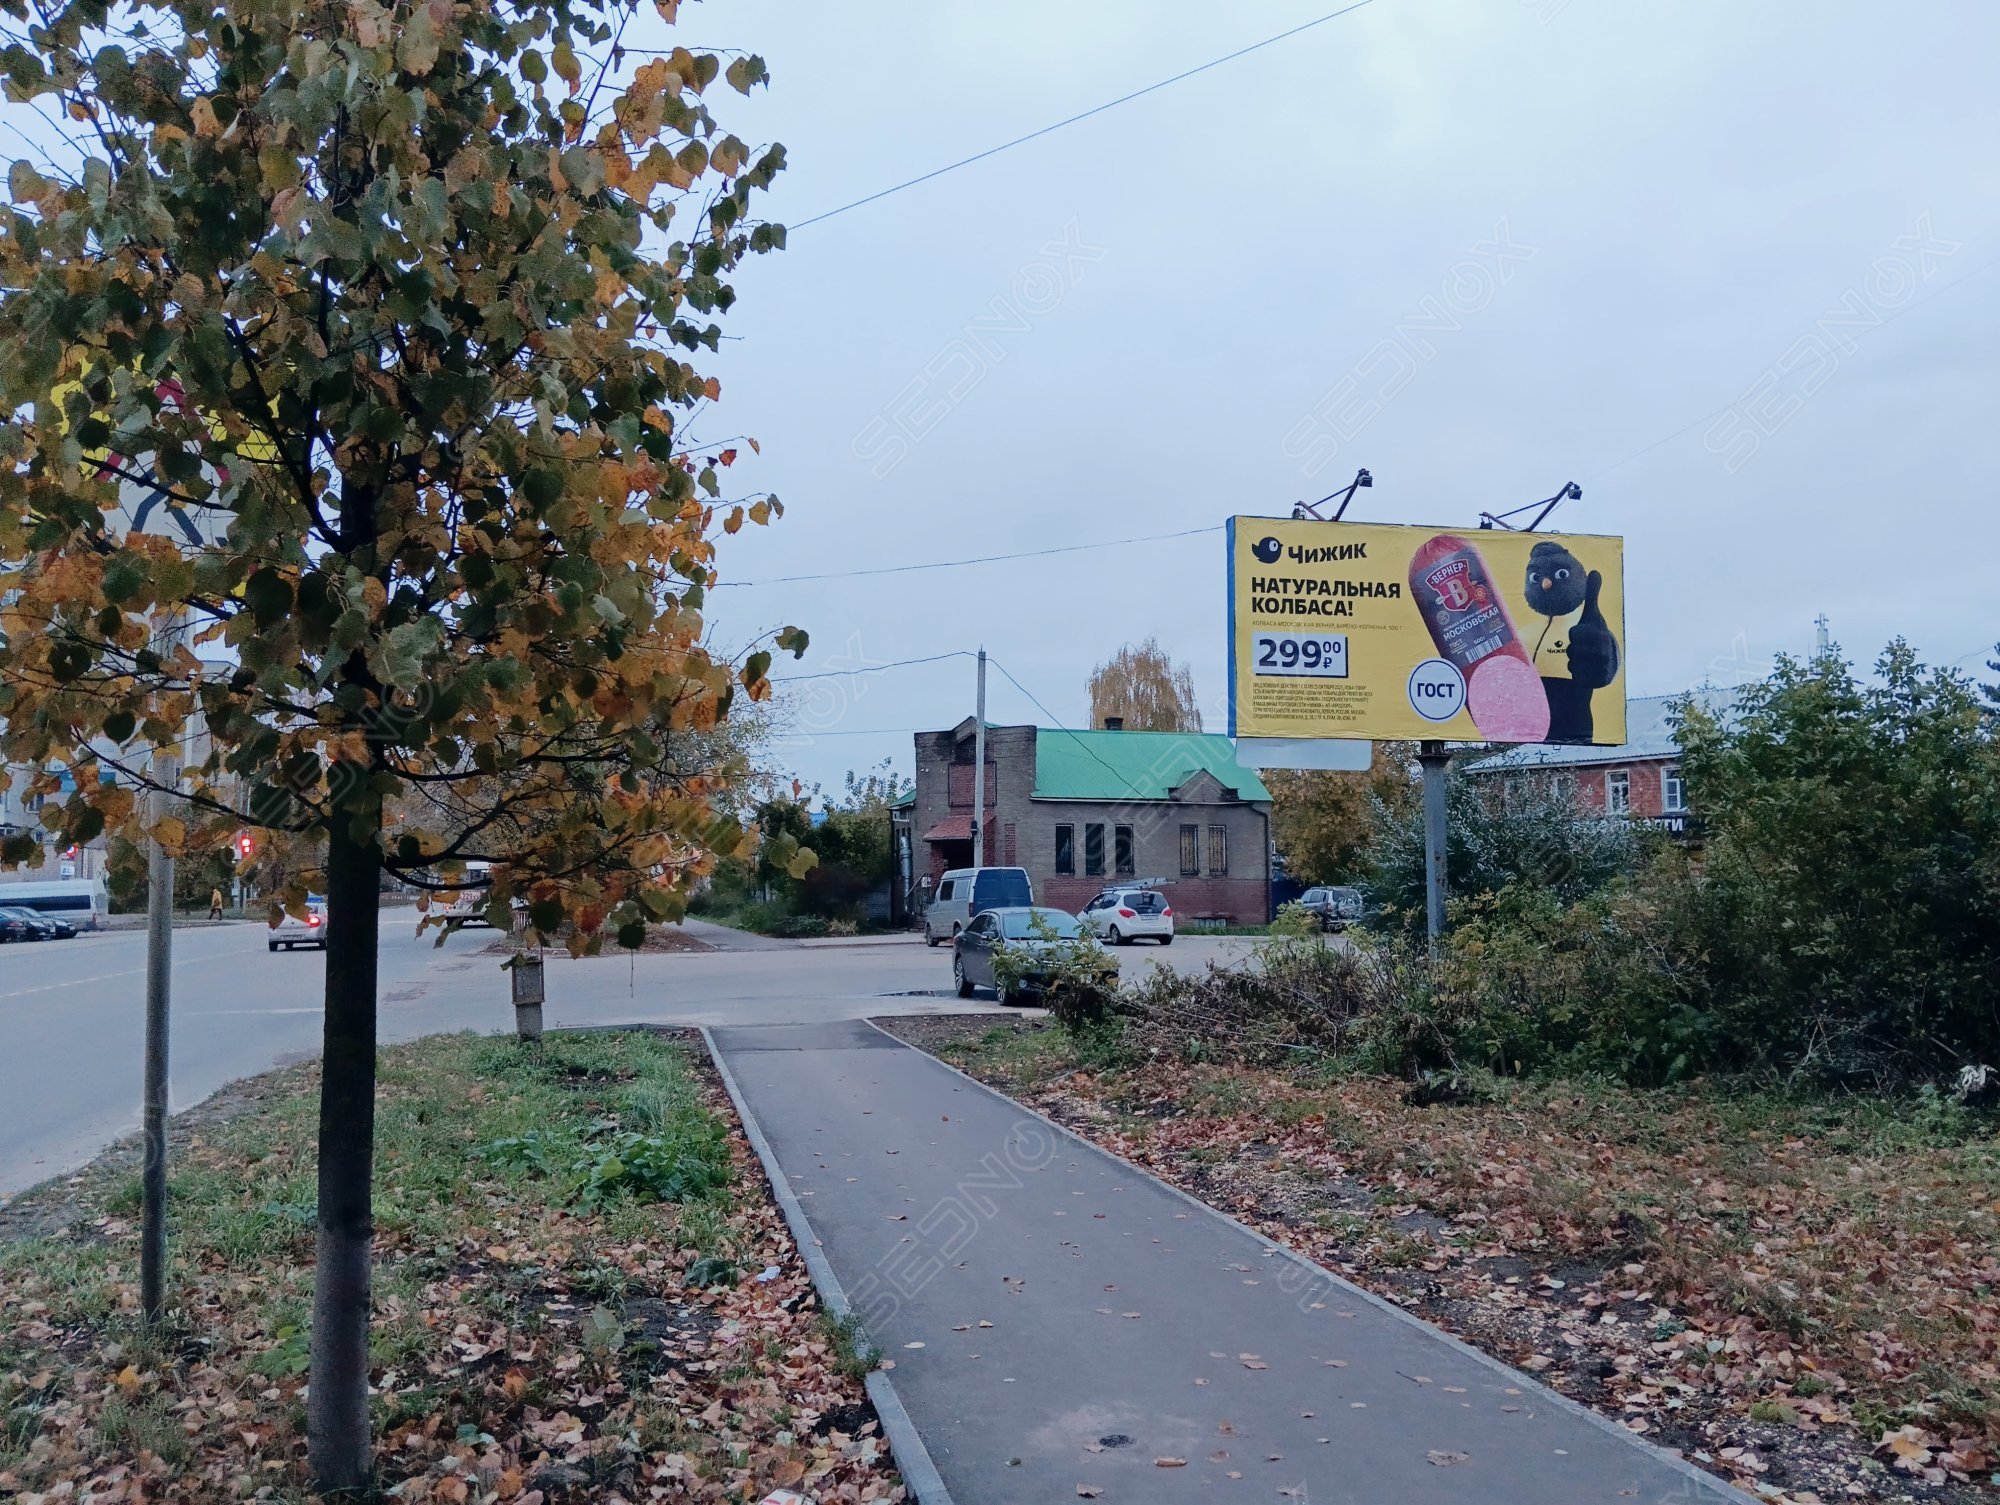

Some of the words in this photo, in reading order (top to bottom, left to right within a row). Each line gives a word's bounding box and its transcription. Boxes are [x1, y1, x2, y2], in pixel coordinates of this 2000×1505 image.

[1288, 543, 1367, 564] Чижик
[1431, 562, 1465, 584] ВЕРНЕР
[1252, 577, 1401, 598] НАТУРАЛЬНАЯ
[1252, 597, 1353, 616] КОЛБАСА!
[1443, 606, 1500, 641] МОСКОВСКАЯ
[1258, 638, 1322, 669] 299
[1322, 641, 1342, 654] 00
[1417, 682, 1455, 698] ГОСТ
